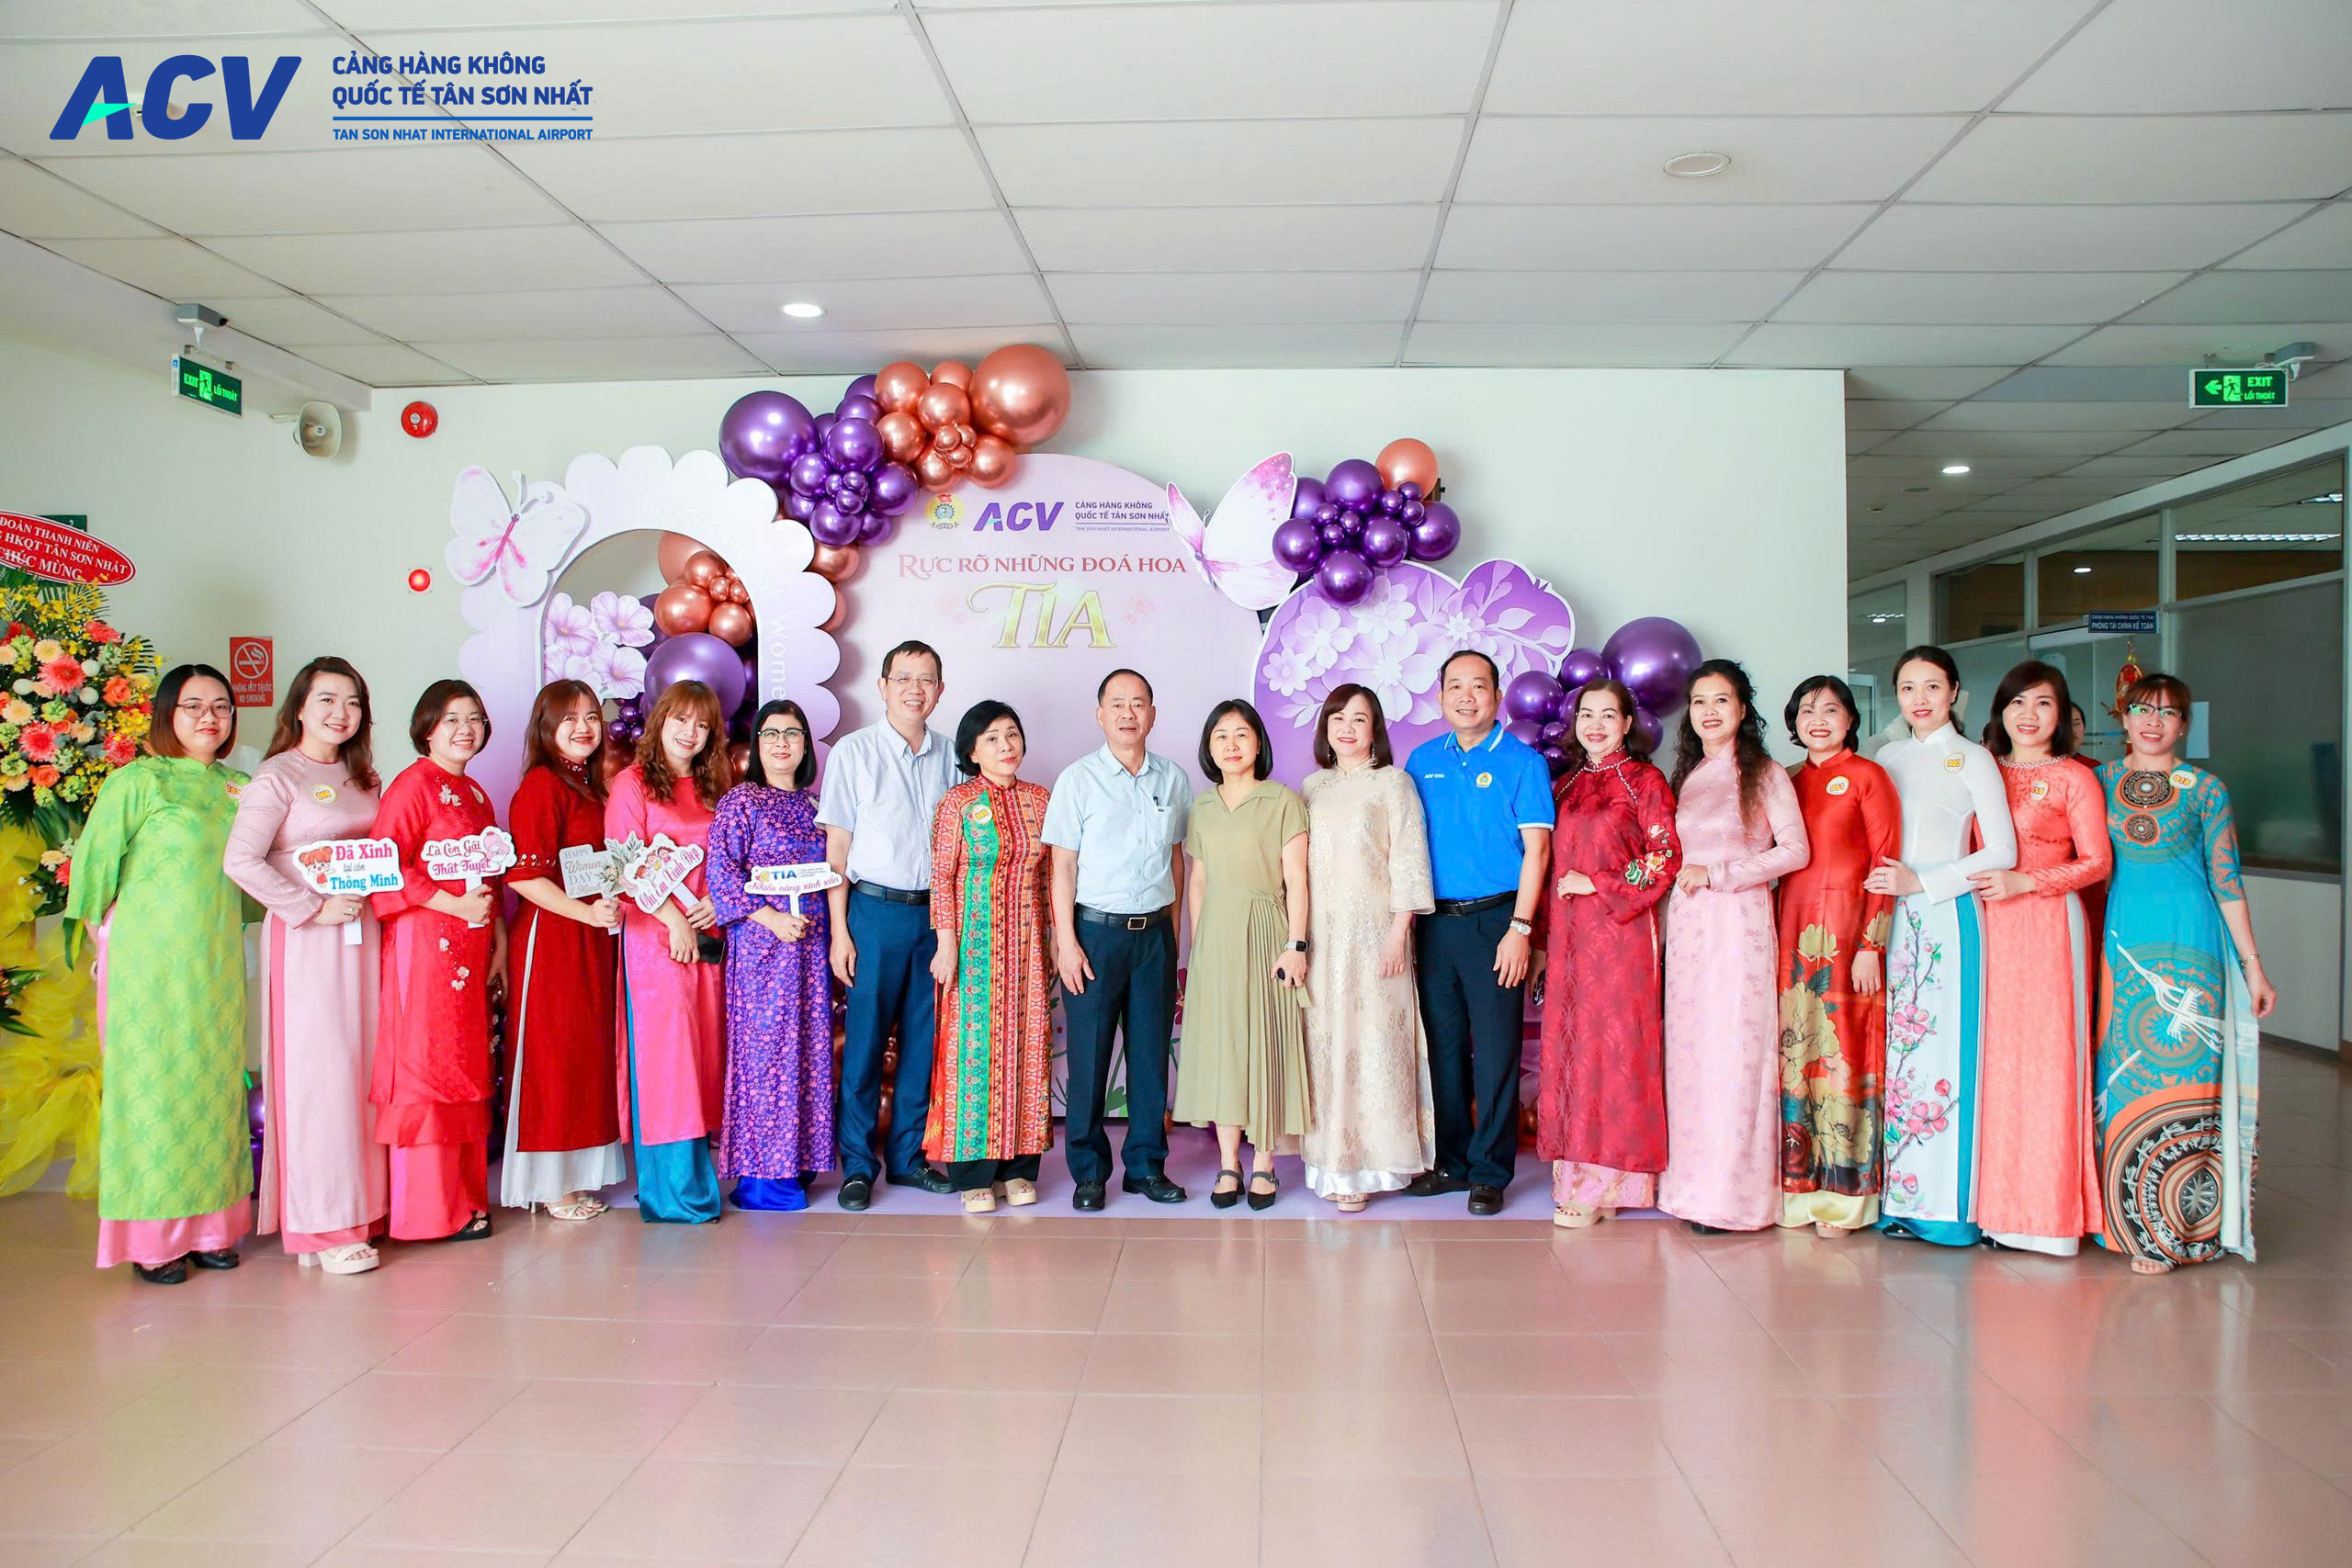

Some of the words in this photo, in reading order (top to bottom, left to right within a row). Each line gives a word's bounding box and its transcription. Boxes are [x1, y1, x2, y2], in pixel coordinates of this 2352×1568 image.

[184, 373, 199, 388] EXIT
[2247, 376, 2273, 387] EXIT
[1075, 500, 1097, 509] CẢNG
[1099, 501, 1122, 509] HÀNG
[1124, 501, 1153, 509] KHÔNG
[973, 502, 1065, 531] ACV
[1075, 510, 1097, 521] QUỐC
[1099, 510, 1109, 519] TẾ
[1111, 511, 1126, 519] TÂN
[1148, 510, 1170, 520] NHẤT
[0, 516, 32, 534] ĐOÀN
[34, 526, 72, 545] THANH
[74, 536, 99, 554] NIÊN
[5, 532, 42, 551] HKQT
[44, 543, 70, 559] TÂN
[70, 551, 93, 567] SƠN
[39, 558, 83, 581] MỪNG
[958, 554, 989, 572] RỠ
[995, 554, 1074, 572] NHỮNG
[1081, 554, 1133, 572] ĐOÁ
[1138, 557, 1187, 573] HOA
[967, 581, 1116, 648] TIA
[764, 610, 795, 701] Wome
[335, 845, 354, 861] Đã
[358, 843, 392, 859] Xinh
[426, 845, 441, 856] Là
[444, 843, 462, 857] Con
[463, 840, 485, 857] Gái
[565, 849, 588, 859] HAPPY
[432, 863, 459, 876] Thật
[771, 870, 797, 880] TIA
[331, 875, 367, 891] Thông
[369, 873, 398, 887] Minh
[569, 871, 593, 886] DAY
